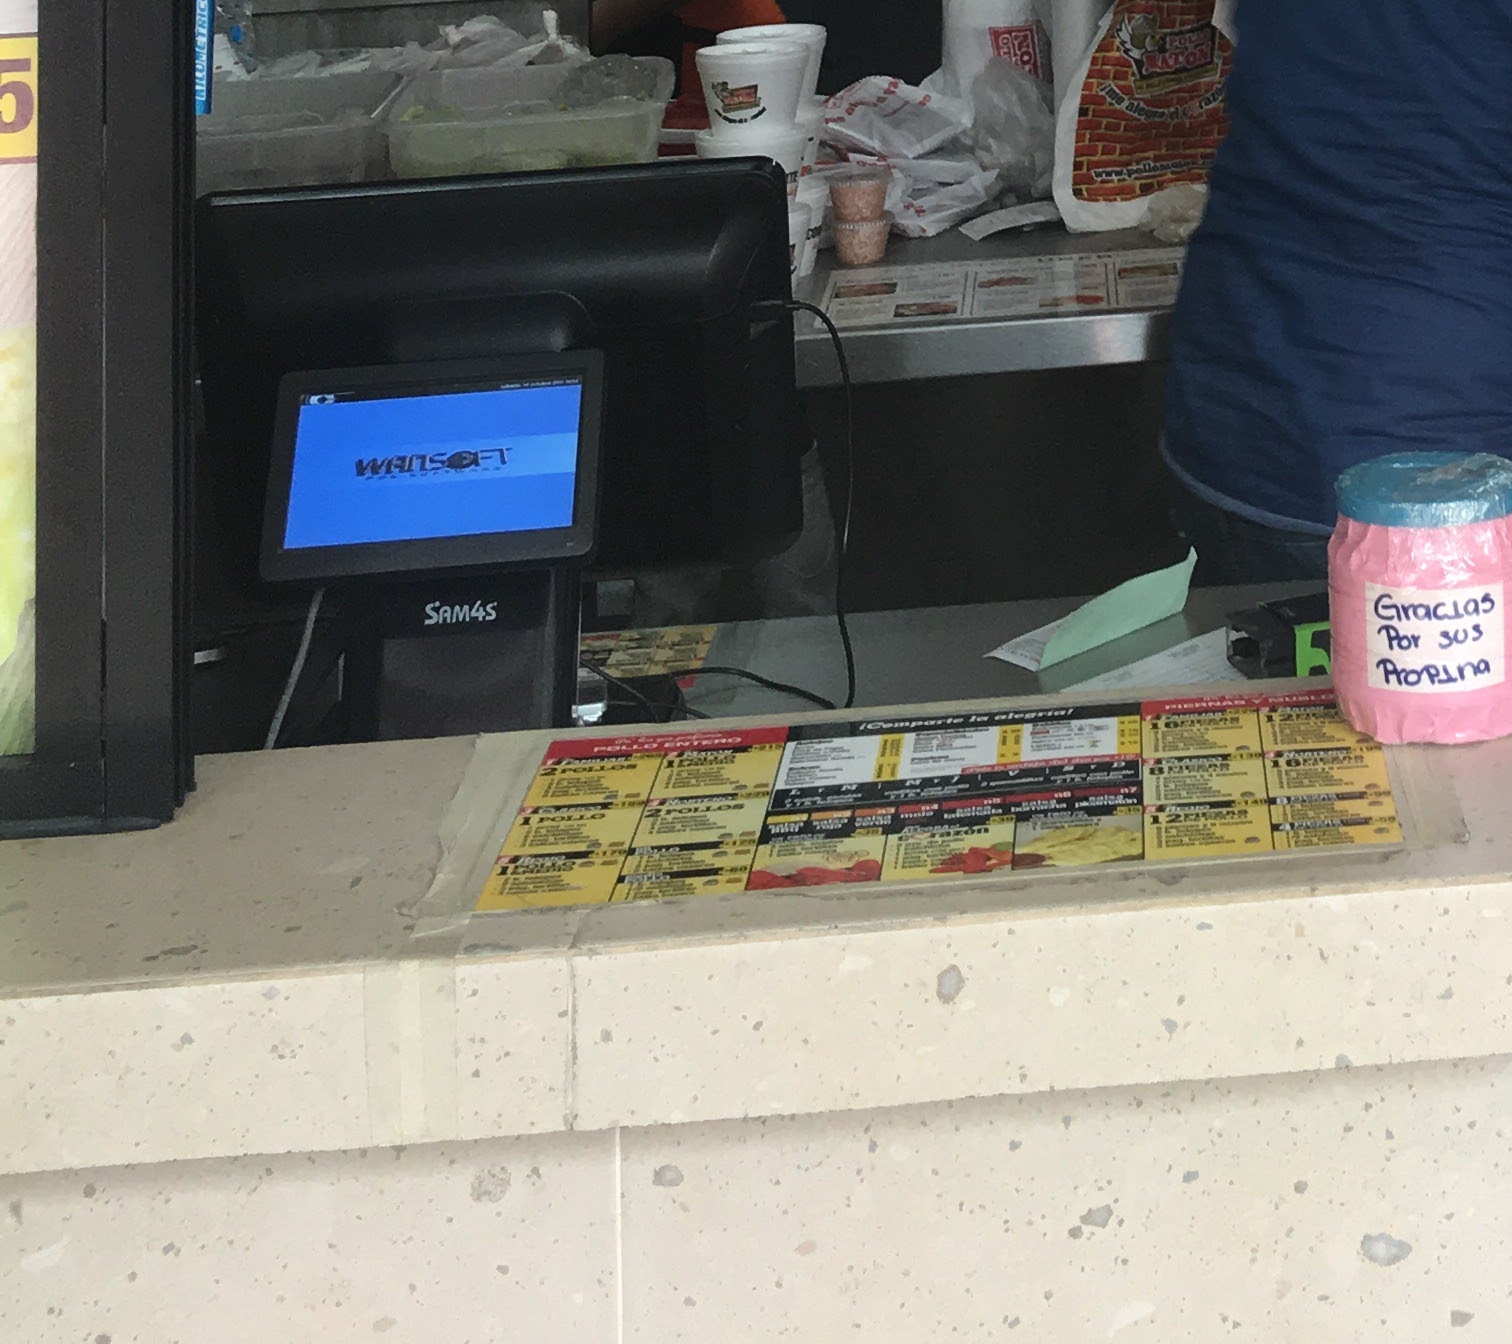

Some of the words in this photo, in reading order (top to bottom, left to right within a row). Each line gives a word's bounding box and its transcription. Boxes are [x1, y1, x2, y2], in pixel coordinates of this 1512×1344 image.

[1373, 591, 1496, 622] Gracias
[1377, 624, 1421, 651] Por
[1438, 623, 1484, 649] sus
[968, 714, 992, 722] la
[592, 743, 658, 752] POLLO
[663, 737, 742, 747] ENTERO
[539, 767, 558, 776] 2
[560, 763, 638, 774] POLLOS
[536, 812, 607, 823] POLLO
[643, 808, 663, 818] 2
[664, 803, 745, 814] POLLOS
